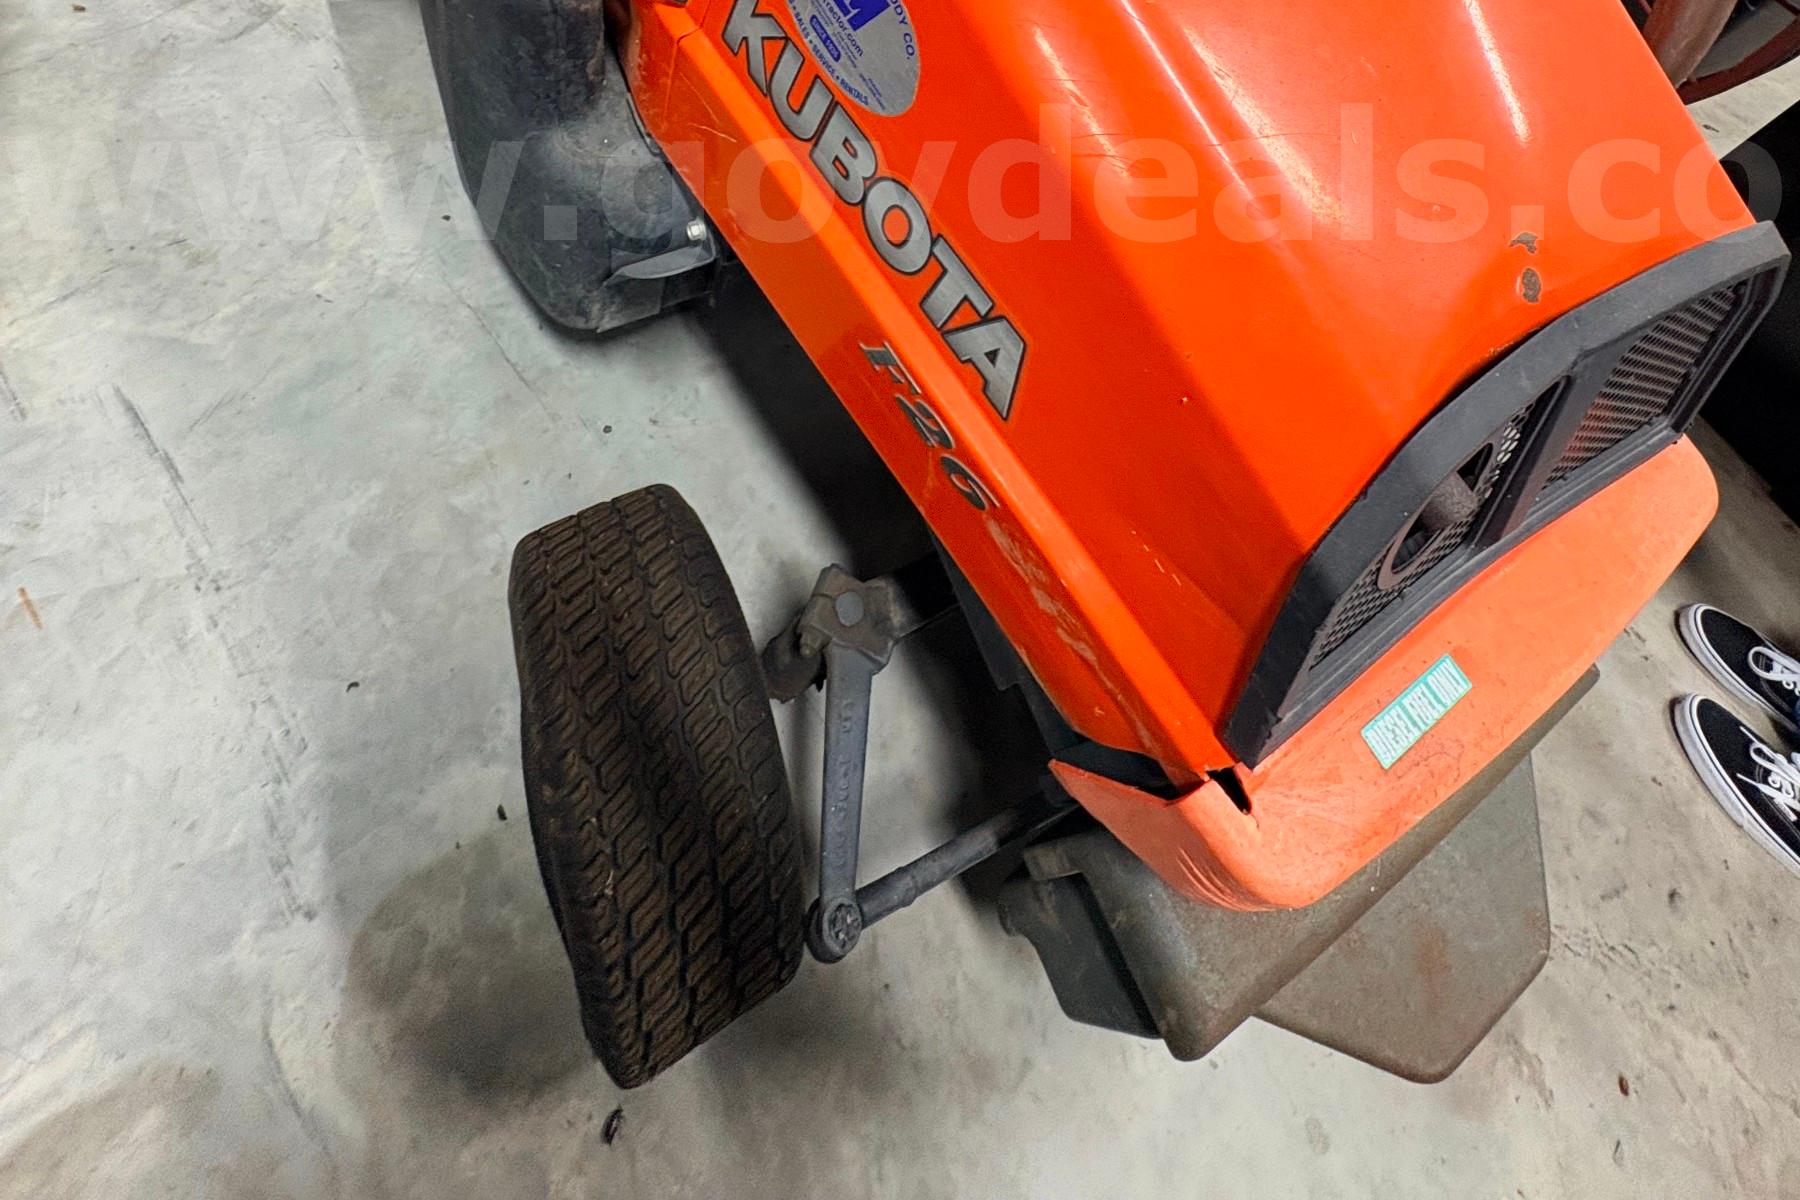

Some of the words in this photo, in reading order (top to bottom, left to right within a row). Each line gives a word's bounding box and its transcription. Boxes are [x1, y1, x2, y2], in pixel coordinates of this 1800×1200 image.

[794, 12, 811, 42] SALES
[811, 45, 836, 75] SERVICE
[839, 78, 869, 106] RENTALS
[903, 32, 916, 60] CO.
[1366, 705, 1418, 762] DIESEL
[1401, 682, 1442, 733] FUEL
[1426, 660, 1467, 707] ONLY
